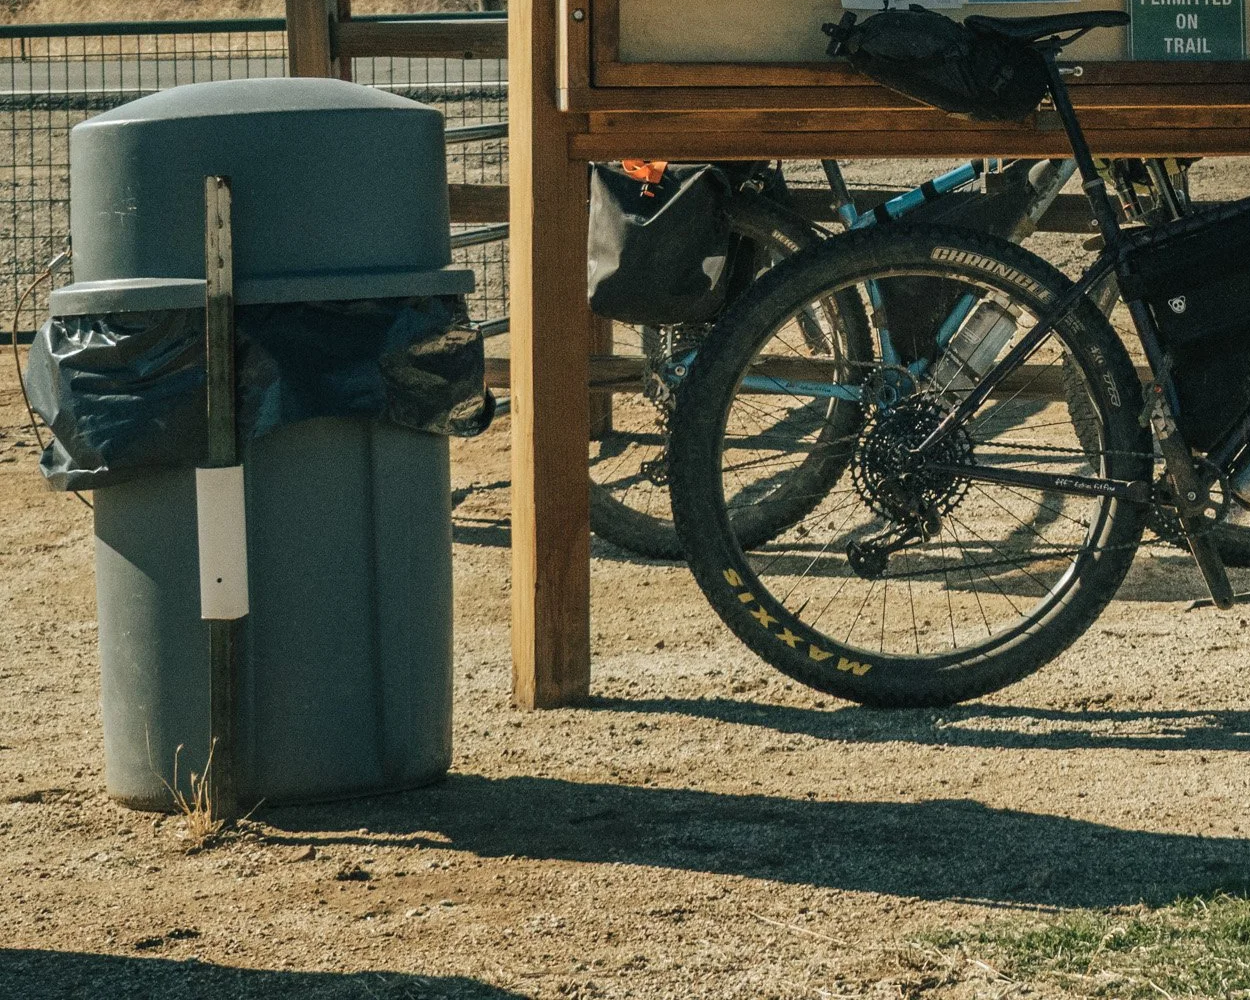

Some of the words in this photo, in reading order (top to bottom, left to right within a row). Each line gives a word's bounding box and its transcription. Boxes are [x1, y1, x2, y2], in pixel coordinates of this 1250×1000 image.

[1176, 14, 1198, 30] ON
[1164, 38, 1212, 54] TRAIL
[930, 247, 1057, 305] CHRONICLE
[722, 568, 873, 676] MAXXIS
